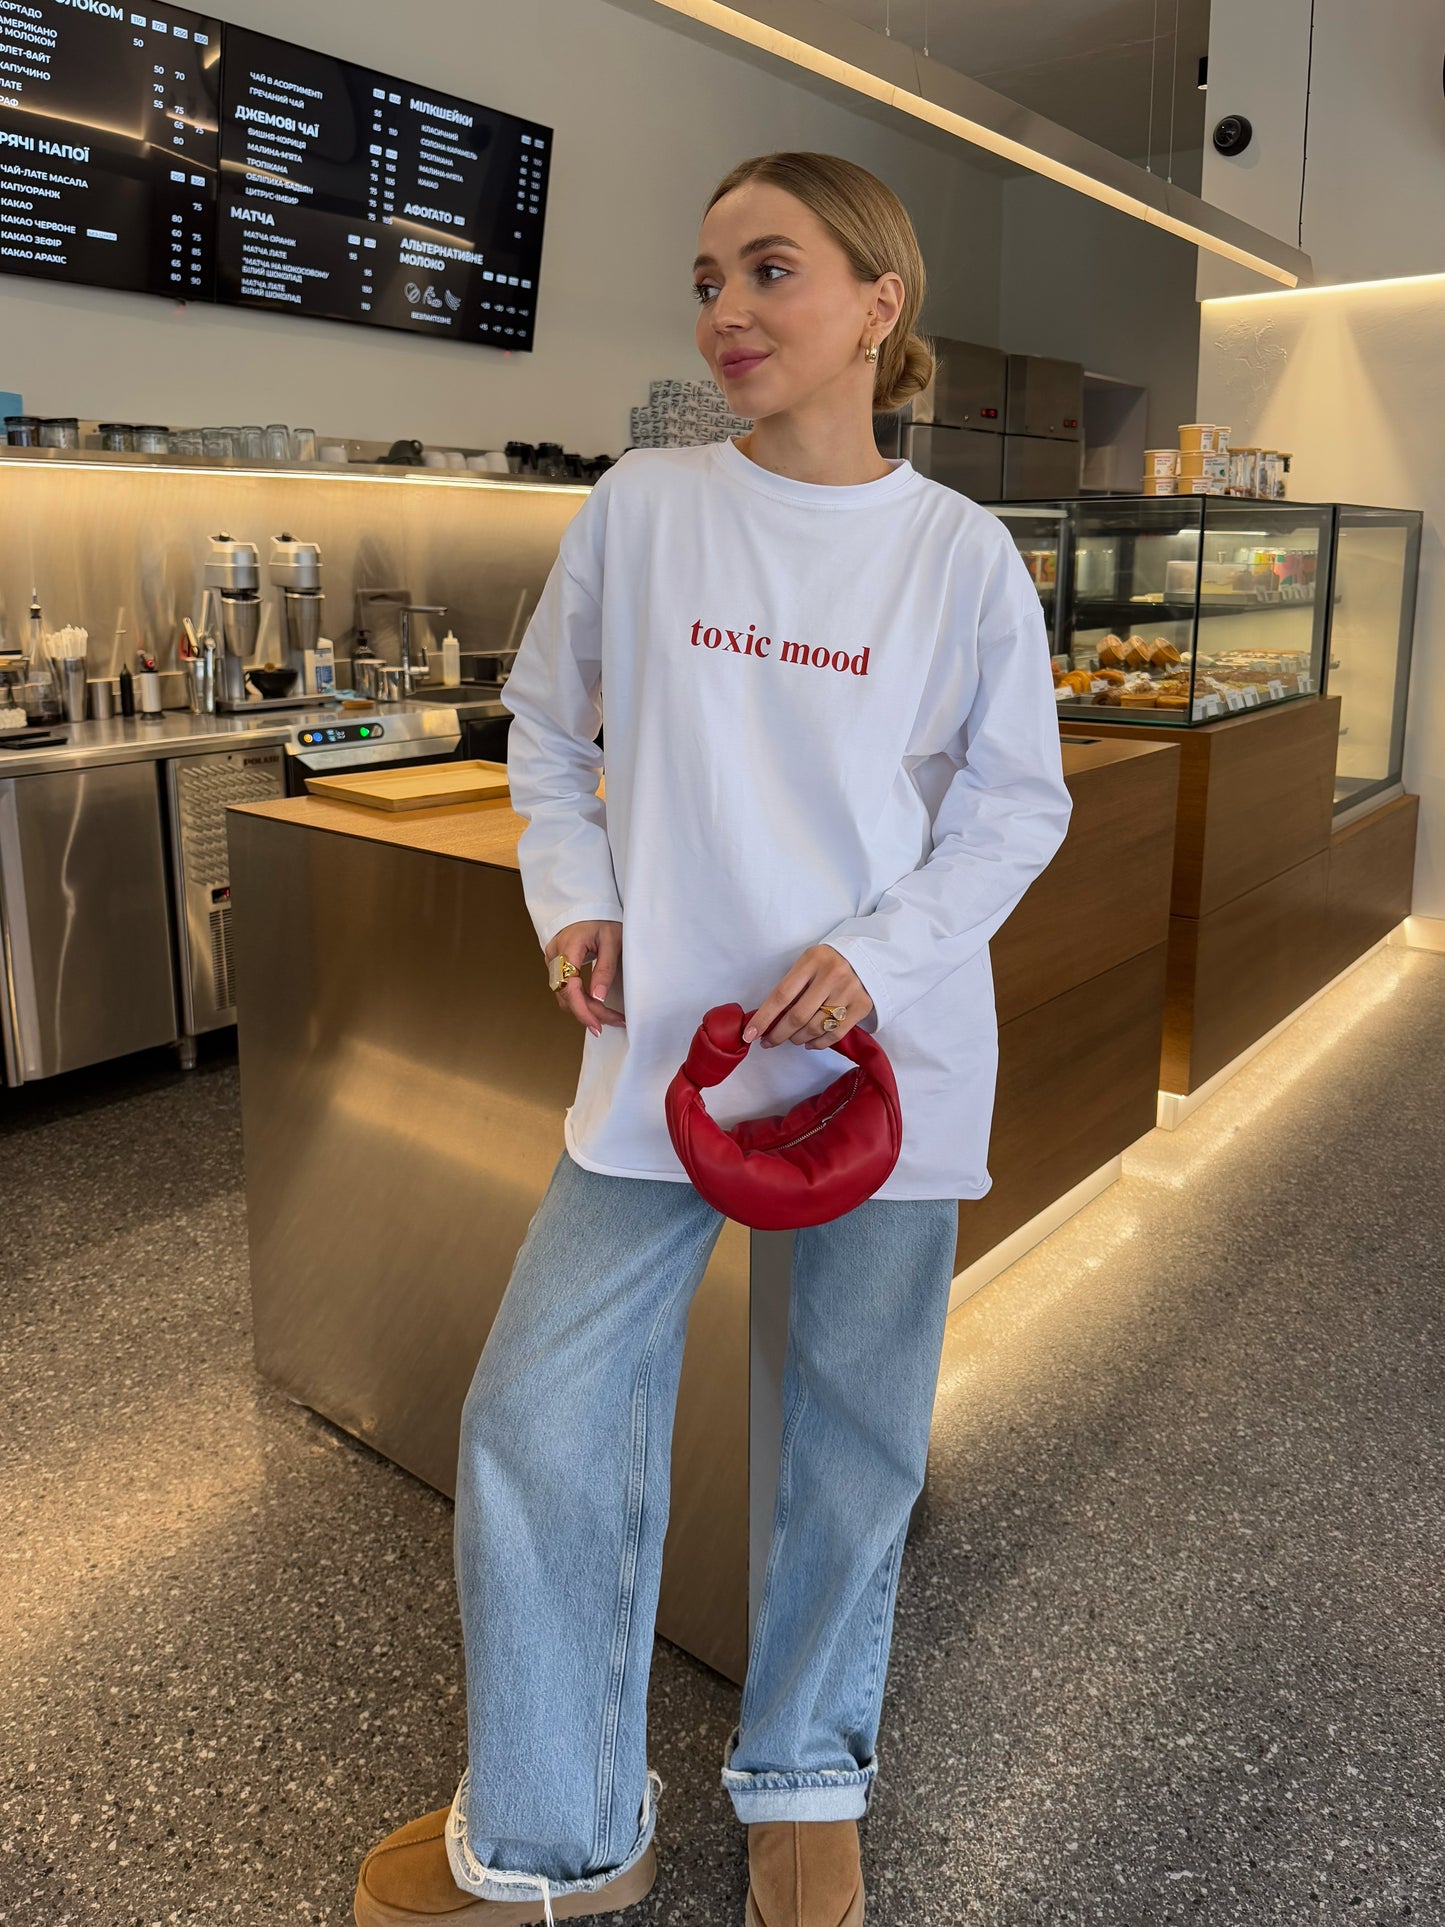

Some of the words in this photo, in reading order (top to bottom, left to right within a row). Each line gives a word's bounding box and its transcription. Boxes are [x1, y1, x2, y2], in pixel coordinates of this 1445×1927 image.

[5, 27, 56, 48] МОЛОКОМ
[133, 37, 144, 48] 50
[153, 64, 165, 75] 50
[175, 71, 186, 81] 70
[153, 83, 164, 93] 70
[249, 71, 266, 83] ЧАЙ
[266, 76, 273, 84] В
[273, 79, 323, 100] АСОРТИМЕНТІ
[153, 99, 164, 109] 55
[174, 105, 185, 115] 75
[248, 86, 288, 105] ГРЕЧАНИЙ
[288, 98, 304, 110] ЧАЙ
[409, 97, 474, 128] МІЛКШЕЙКИ
[173, 121, 184, 130] 65
[194, 125, 205, 135] 75
[235, 105, 296, 132] ДЖЕМОВІ
[297, 121, 320, 139] ЧАЇ
[173, 136, 184, 146] 80
[247, 127, 307, 150] ВИШНЯ-КОРИЦЯ
[39, 139, 90, 163] НАПОЇ
[246, 157, 289, 175] ТРОПІКАНА
[0, 163, 48, 181] ЧАЙ-ЛАТЕ
[48, 173, 89, 189] МАСАЛА
[0, 181, 61, 200] КАПУОРАНЖ
[0, 197, 34, 211] КАКАО
[192, 202, 203, 212] 75
[403, 202, 453, 224] АФОГАТО
[0, 214, 34, 227] КАКАО
[34, 220, 77, 235] ЧЕРВОНЕ
[171, 214, 183, 224] 80
[230, 205, 276, 227] МАТЧА
[0, 230, 34, 243] КАКАО
[34, 236, 62, 248] ЗЕФІР
[192, 233, 202, 242] 75
[243, 229, 269, 242] МАТЧА
[269, 235, 297, 247] ОРАНЖ
[0, 246, 34, 259] КАКАО
[34, 252, 68, 265] АРАХІС
[171, 243, 182, 253] 70
[242, 244, 268, 256] МАТЧА
[269, 248, 288, 260] ЛАТЕ
[400, 238, 484, 266] АЛЬТЕРНАТИВНЕ
[399, 252, 445, 272] МОЛОКО
[241, 278, 267, 289] МАТЧА
[690, 618, 772, 659] toxic
[779, 640, 872, 677] mood
